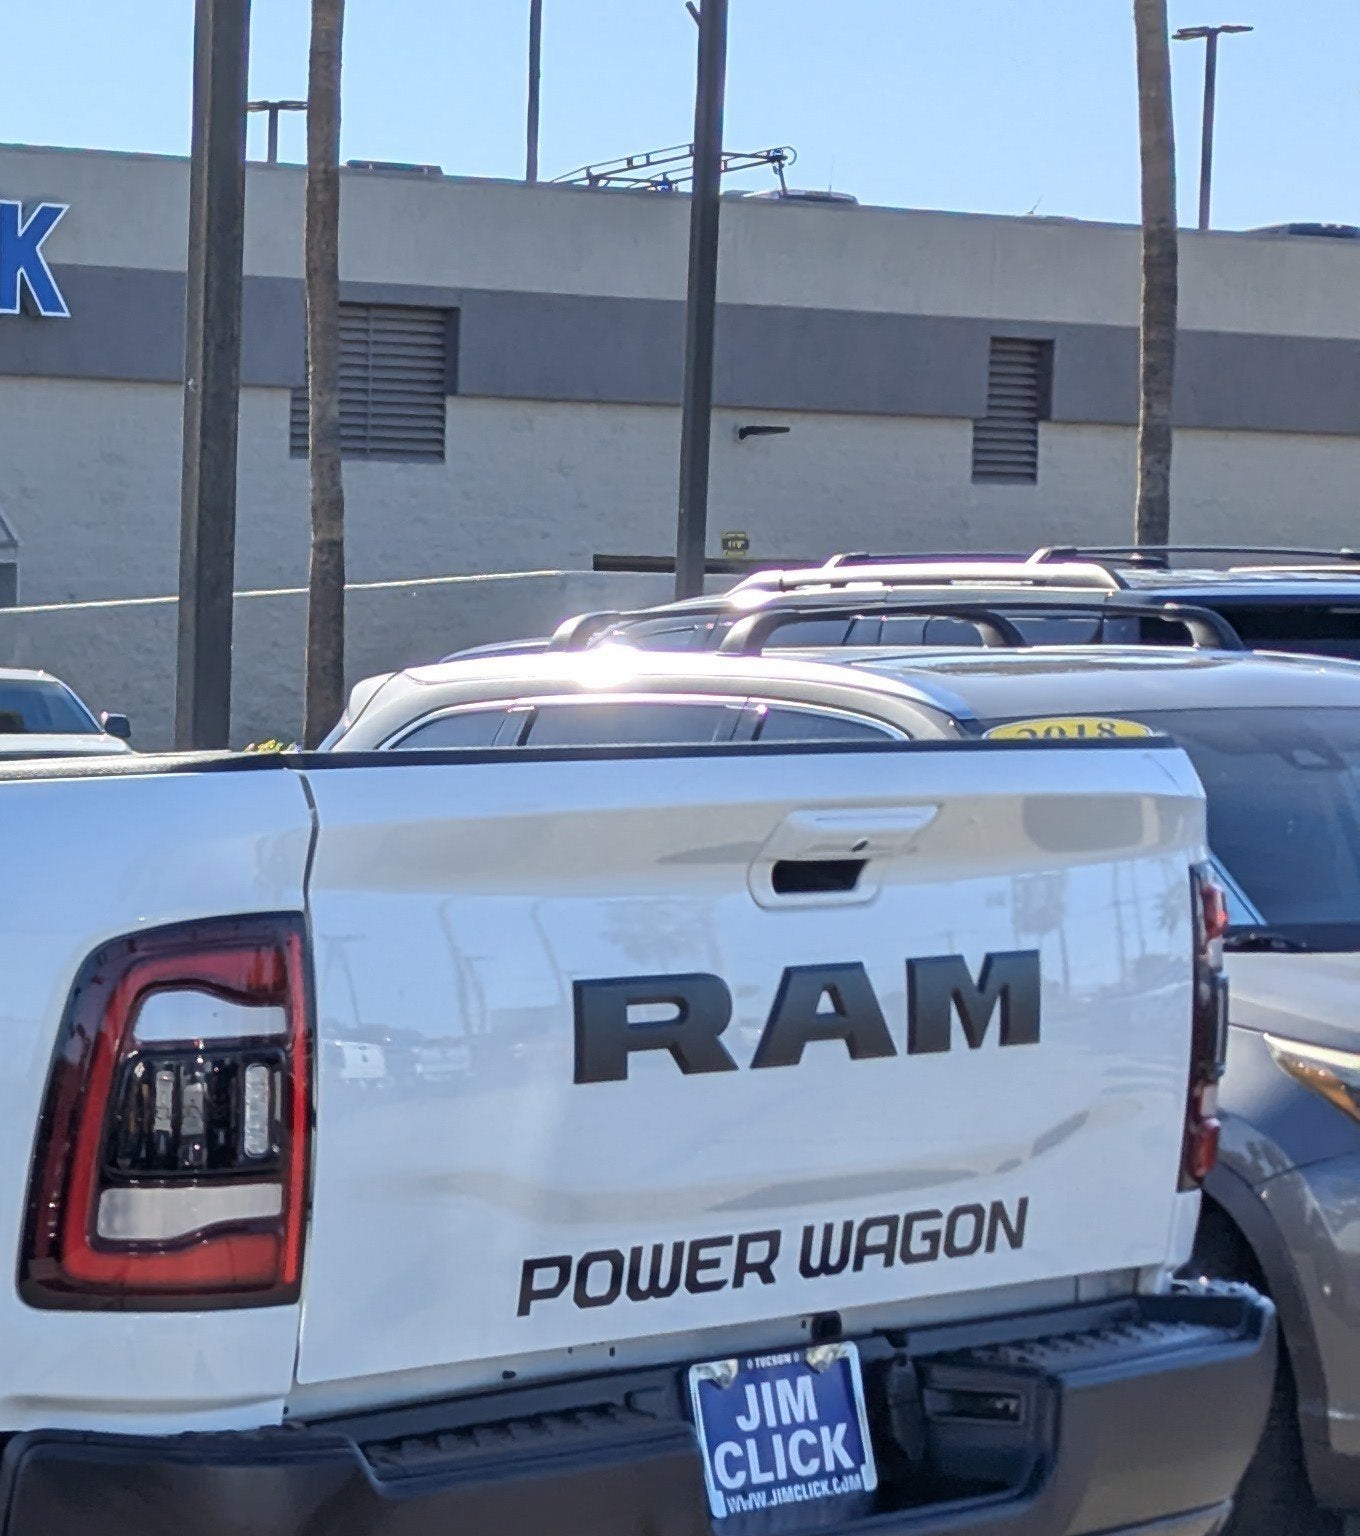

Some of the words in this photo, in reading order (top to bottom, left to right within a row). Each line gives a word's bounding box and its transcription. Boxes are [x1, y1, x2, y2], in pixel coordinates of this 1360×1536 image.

[571, 949, 1041, 1085] RAM
[515, 1230, 780, 1317] POWER
[799, 1197, 1029, 1278] WAGON
[754, 1352, 792, 1368] TUCSON
[736, 1374, 818, 1432] JIM
[714, 1422, 855, 1489] CLICK
